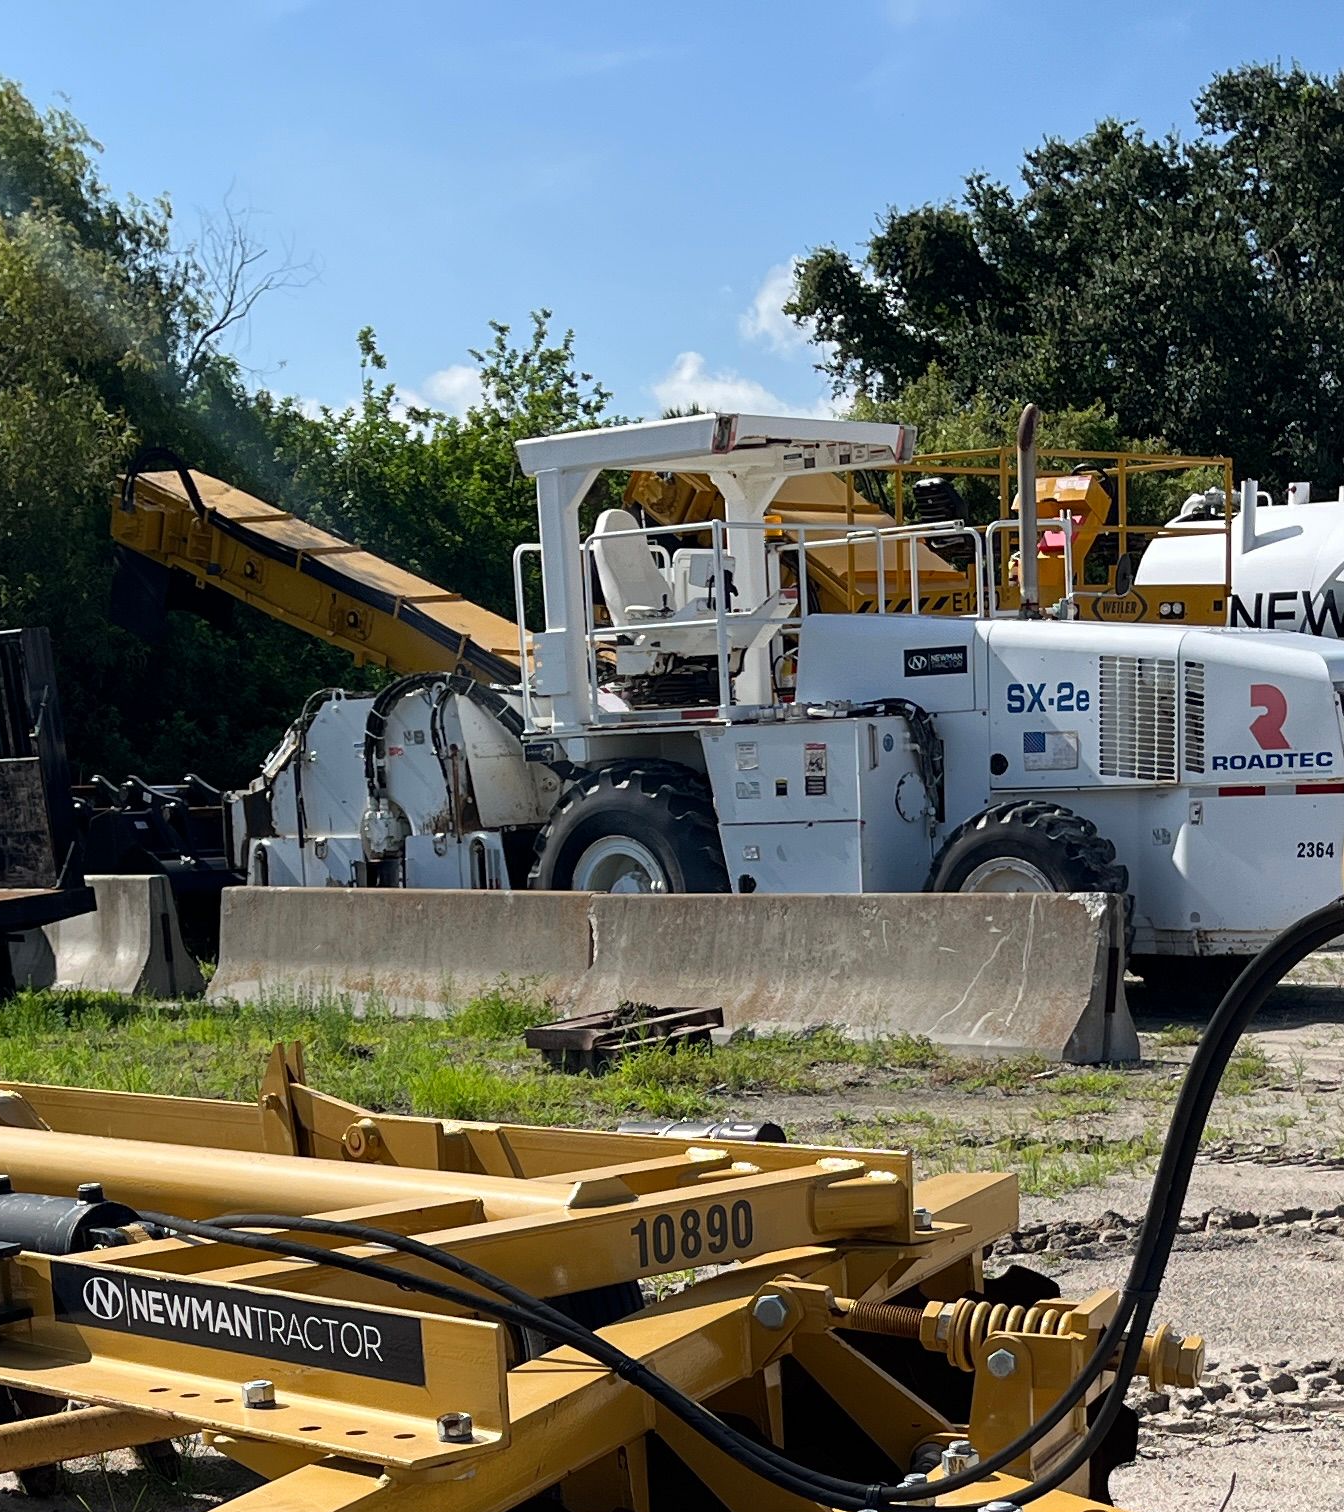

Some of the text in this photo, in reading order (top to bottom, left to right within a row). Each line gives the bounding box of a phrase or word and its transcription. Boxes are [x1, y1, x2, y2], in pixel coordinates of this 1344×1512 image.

[1102, 601, 1137, 614] WEILER
[1212, 752, 1333, 771] ROADTEC
[1296, 841, 1335, 858] 2364
[630, 1199, 753, 1269] 10890
